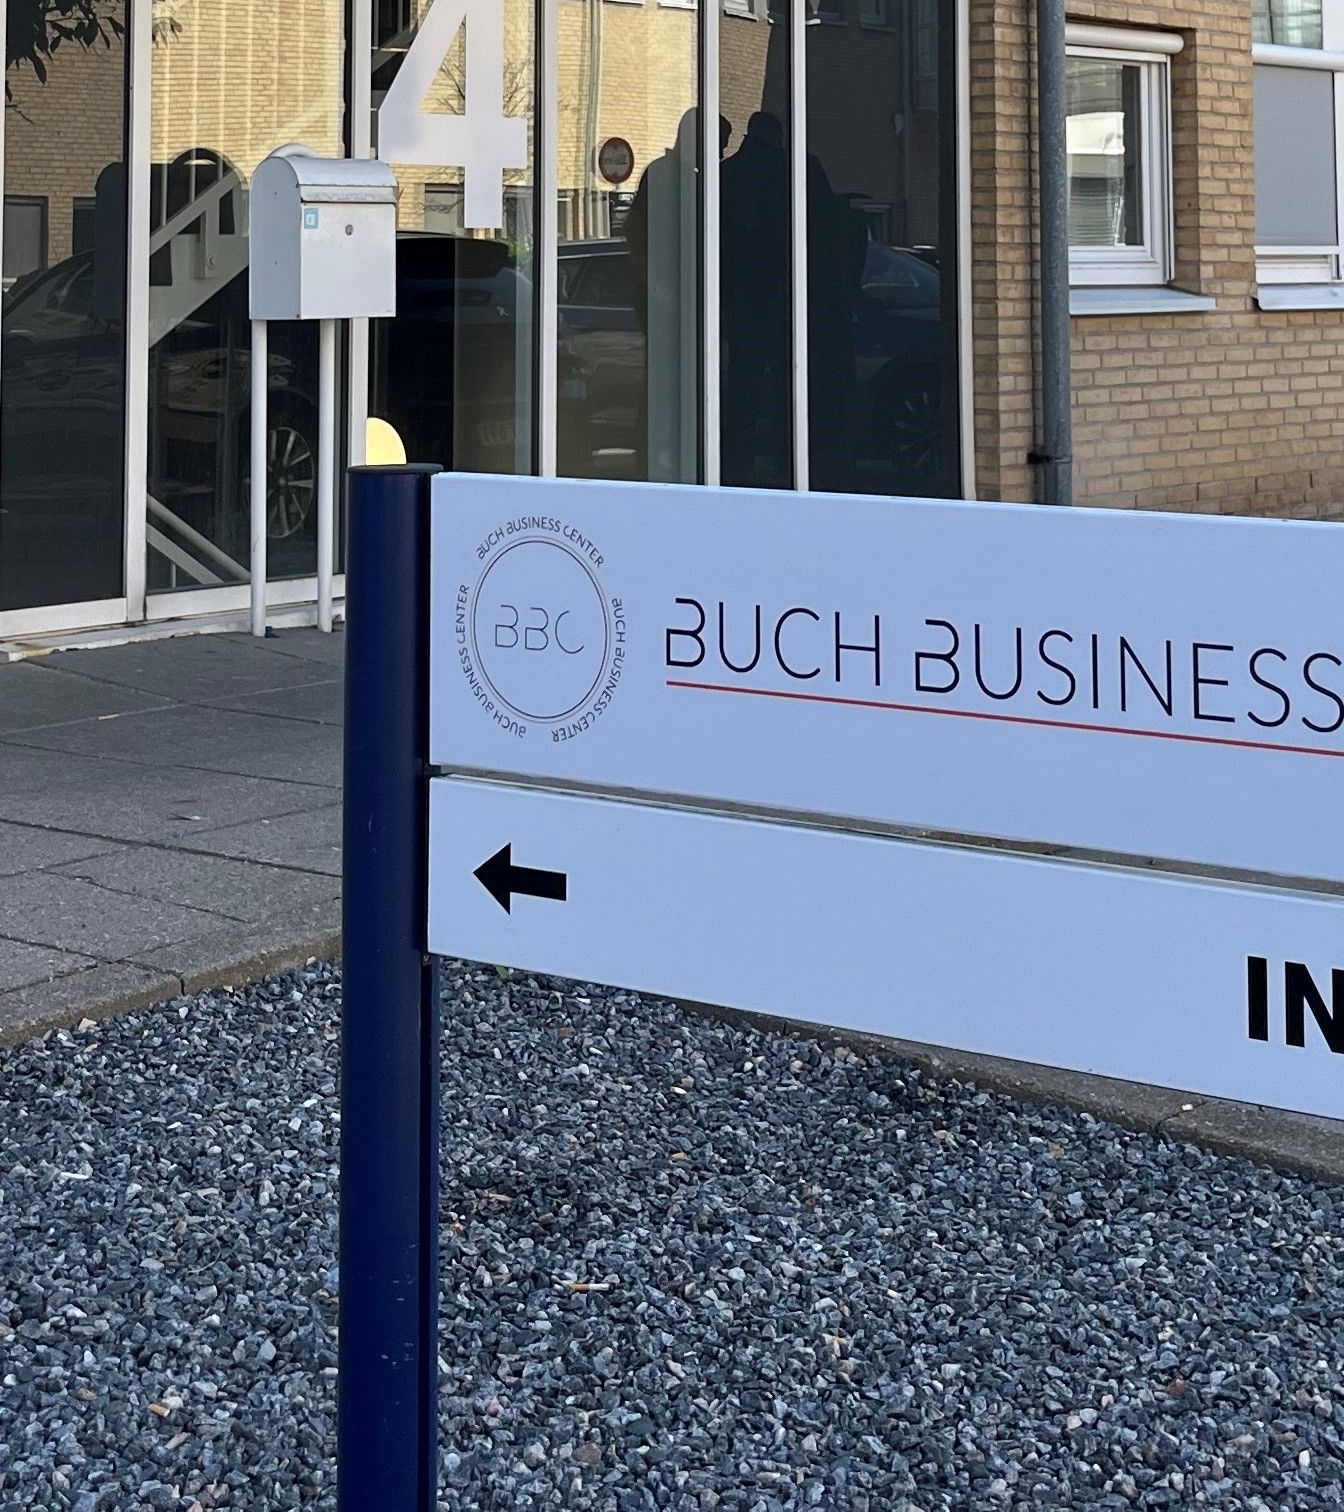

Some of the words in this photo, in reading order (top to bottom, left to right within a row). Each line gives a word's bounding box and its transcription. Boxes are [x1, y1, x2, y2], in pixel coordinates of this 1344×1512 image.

[476, 526, 504, 560] BUCH
[506, 515, 561, 535] BUSINESS
[563, 524, 605, 568] CENTER
[455, 584, 470, 645] CENTER
[494, 603, 586, 655] BBC
[611, 597, 626, 643] BUCH
[665, 596, 881, 687] BUCH
[458, 646, 495, 713] BUSINESS
[593, 649, 626, 716] BUSINESS
[493, 709, 527, 739] BUCH
[551, 711, 596, 743] CENTER
